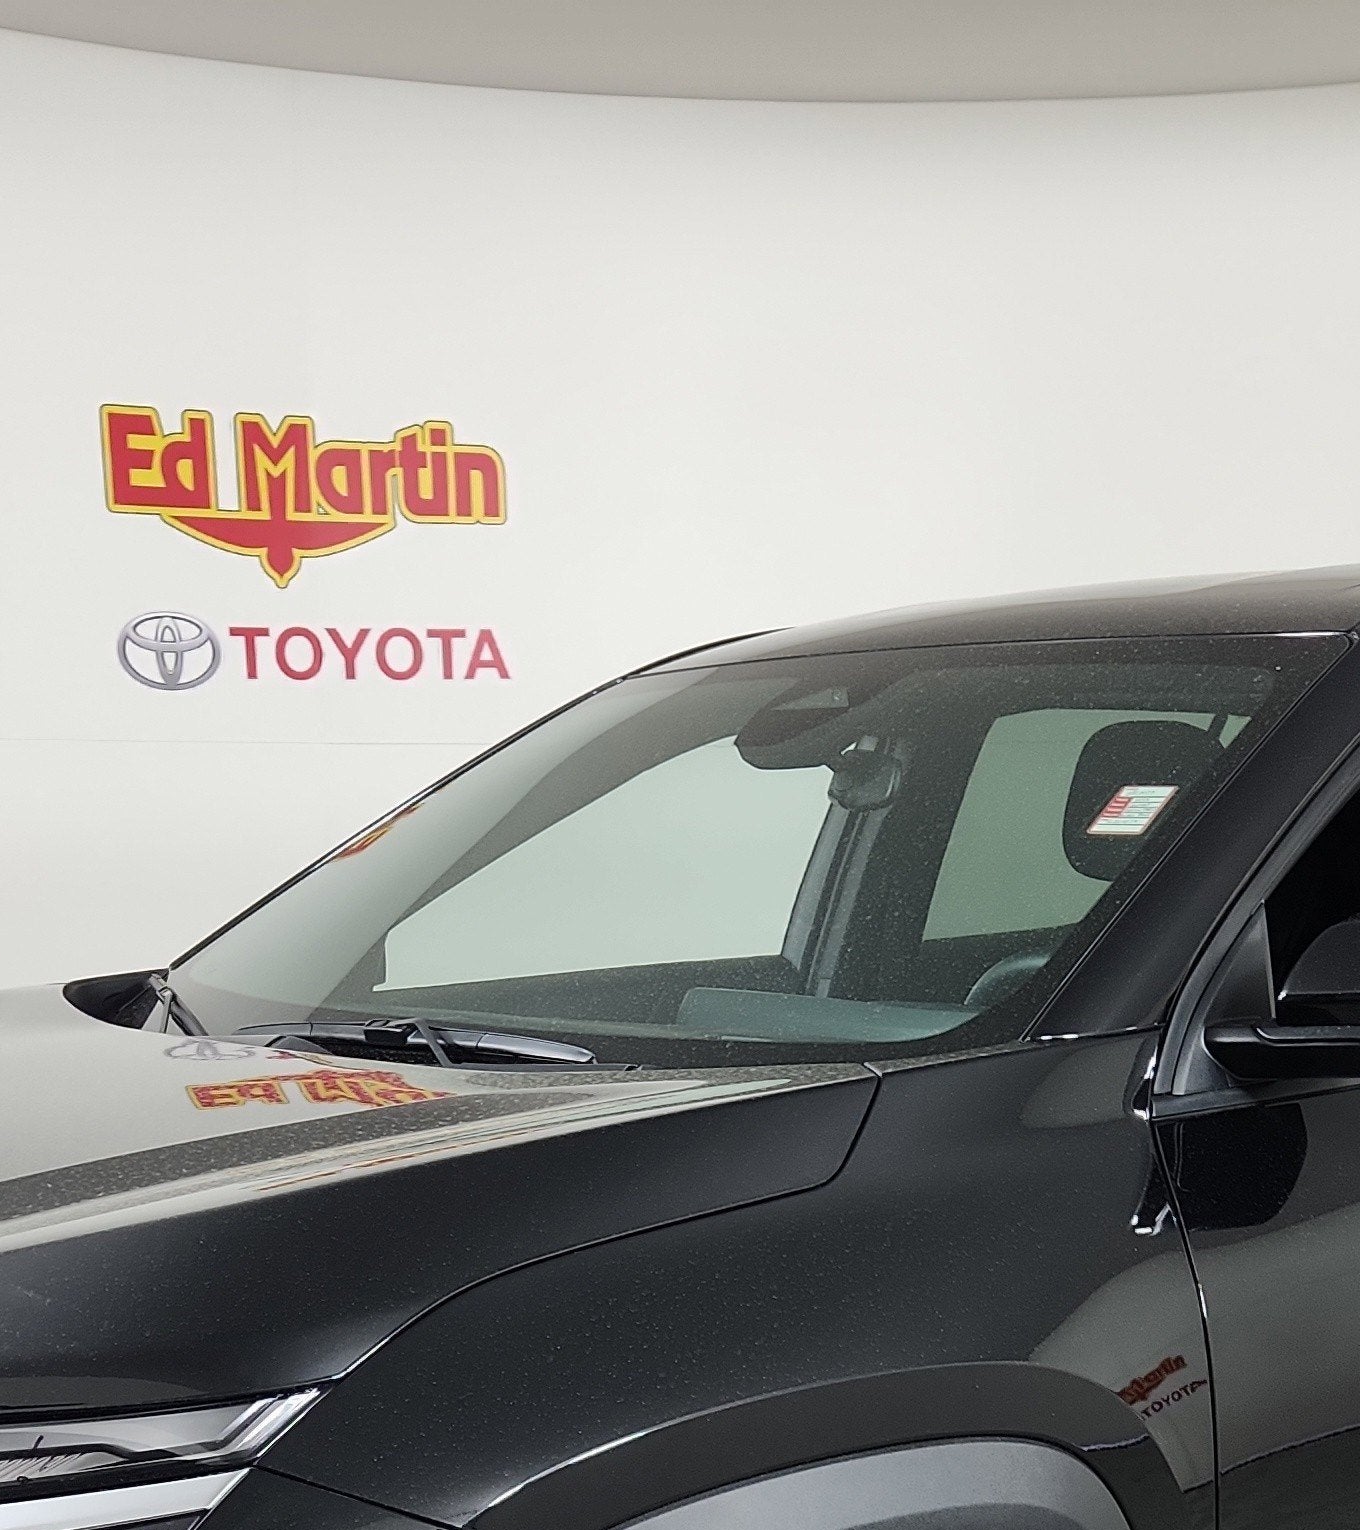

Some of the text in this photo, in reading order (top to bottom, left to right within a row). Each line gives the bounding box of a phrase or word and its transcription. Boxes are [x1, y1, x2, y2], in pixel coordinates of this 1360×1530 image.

[105, 411, 502, 519] Ed Martin
[228, 626, 511, 682] TOYOTA
